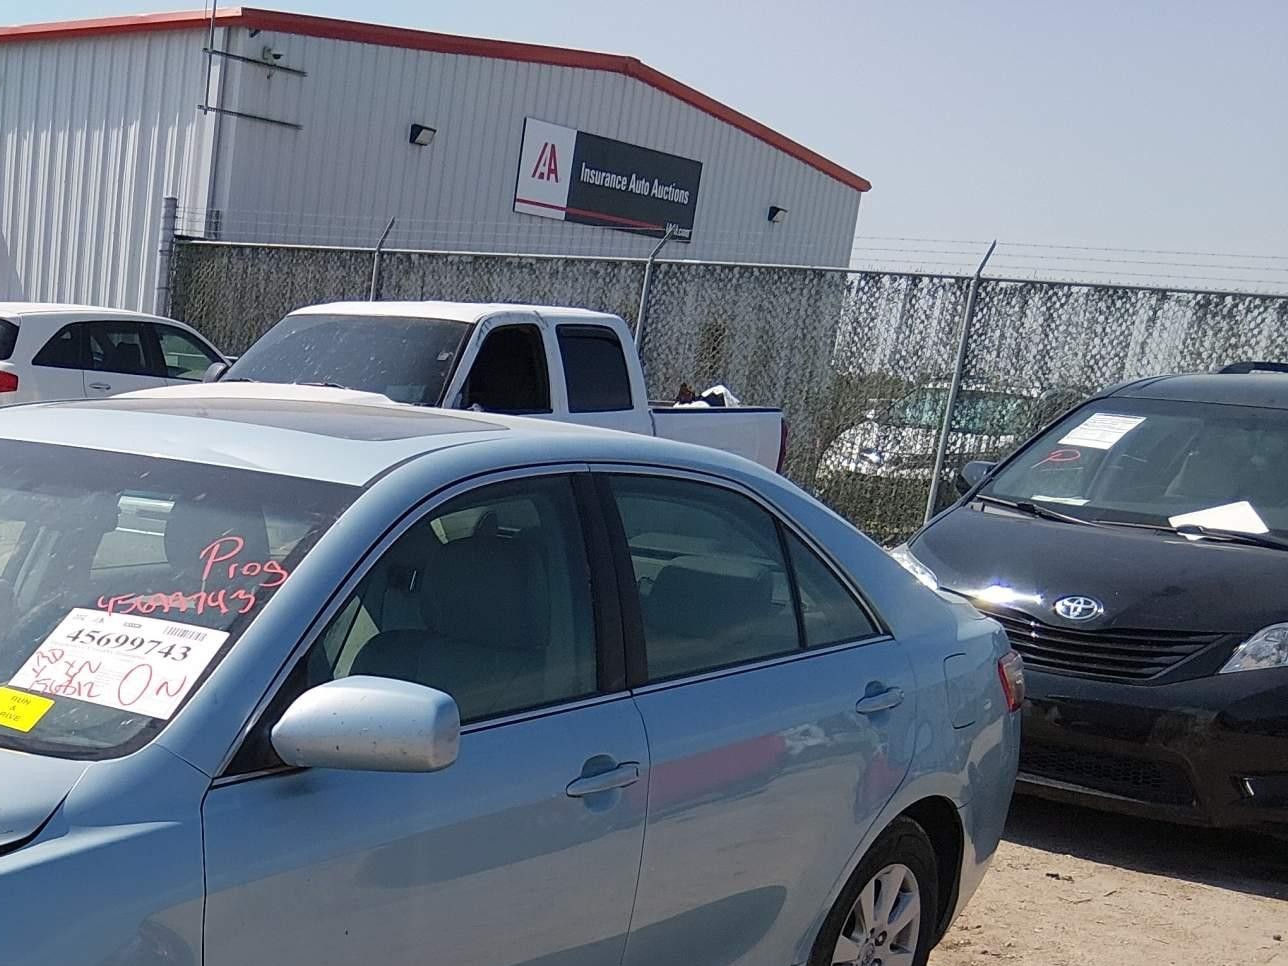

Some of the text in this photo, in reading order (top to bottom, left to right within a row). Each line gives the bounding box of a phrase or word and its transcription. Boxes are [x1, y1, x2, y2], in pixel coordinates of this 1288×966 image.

[580, 162, 690, 204] Insurance Auto Auctions
[66, 628, 193, 662] 45699743
[11, 695, 32, 705] RUN
